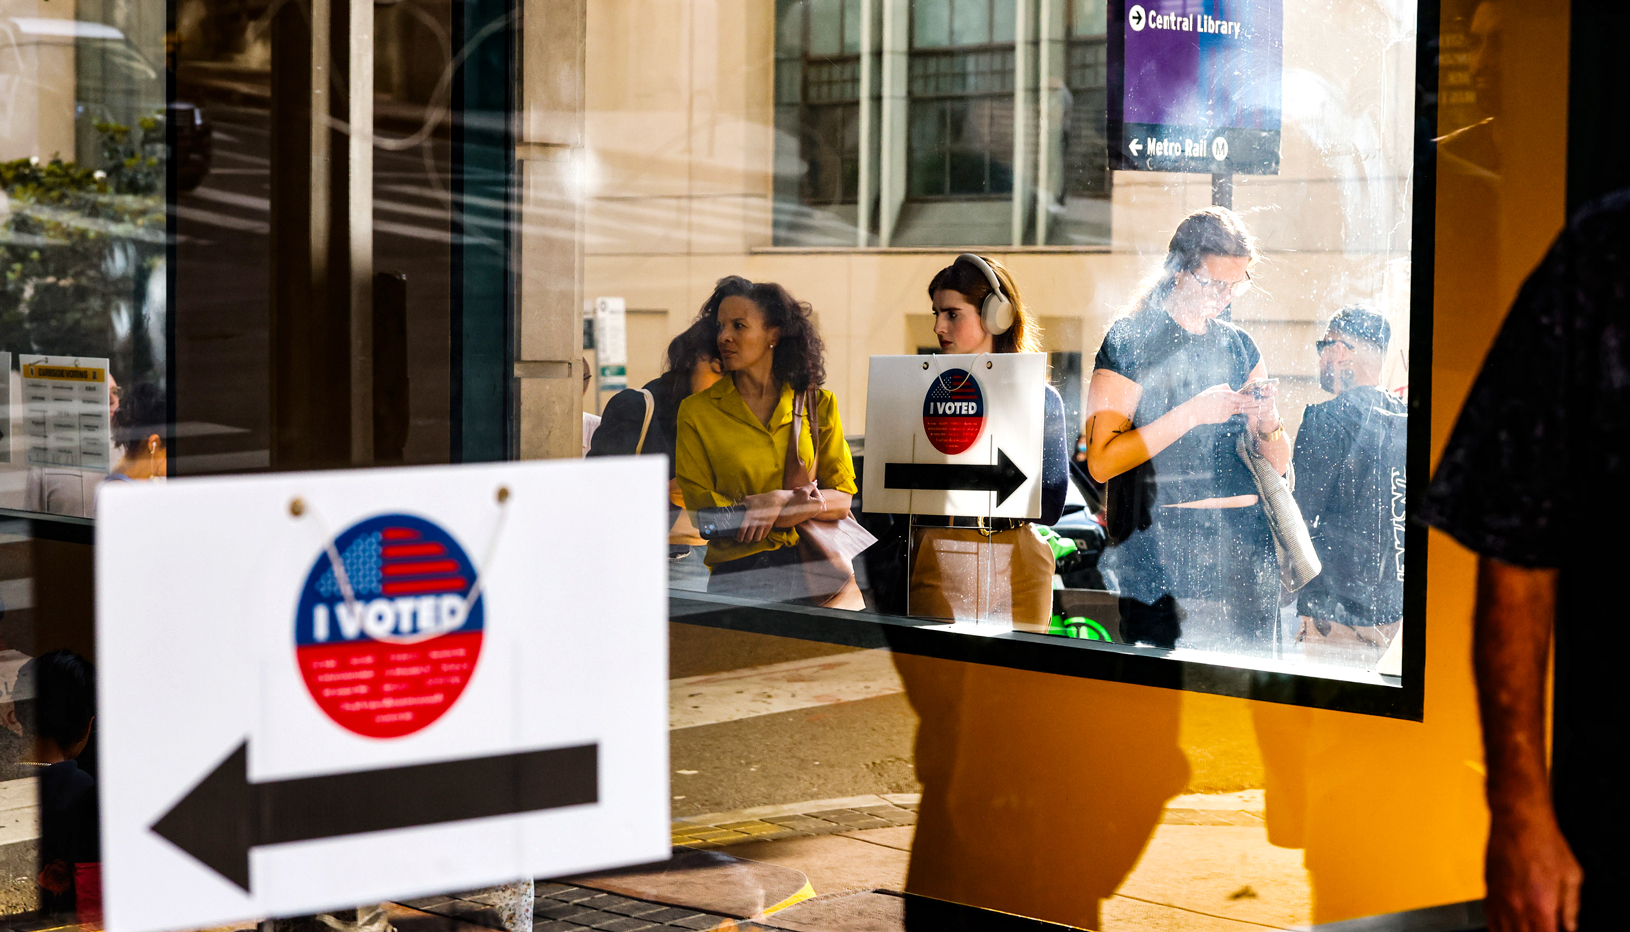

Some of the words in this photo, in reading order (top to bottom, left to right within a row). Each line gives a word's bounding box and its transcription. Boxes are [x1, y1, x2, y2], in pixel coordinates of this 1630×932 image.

[1148, 9, 1193, 32] Central
[1197, 14, 1241, 40] Library
[1147, 137, 1182, 156] Metro
[1184, 138, 1207, 157] Rail
[38, 368, 65, 377] CURBSIDE
[65, 370, 88, 379] VOTING
[930, 402, 934, 415] I
[936, 401, 978, 415] VOTED
[312, 603, 330, 642] I
[334, 593, 468, 640] VOTED
